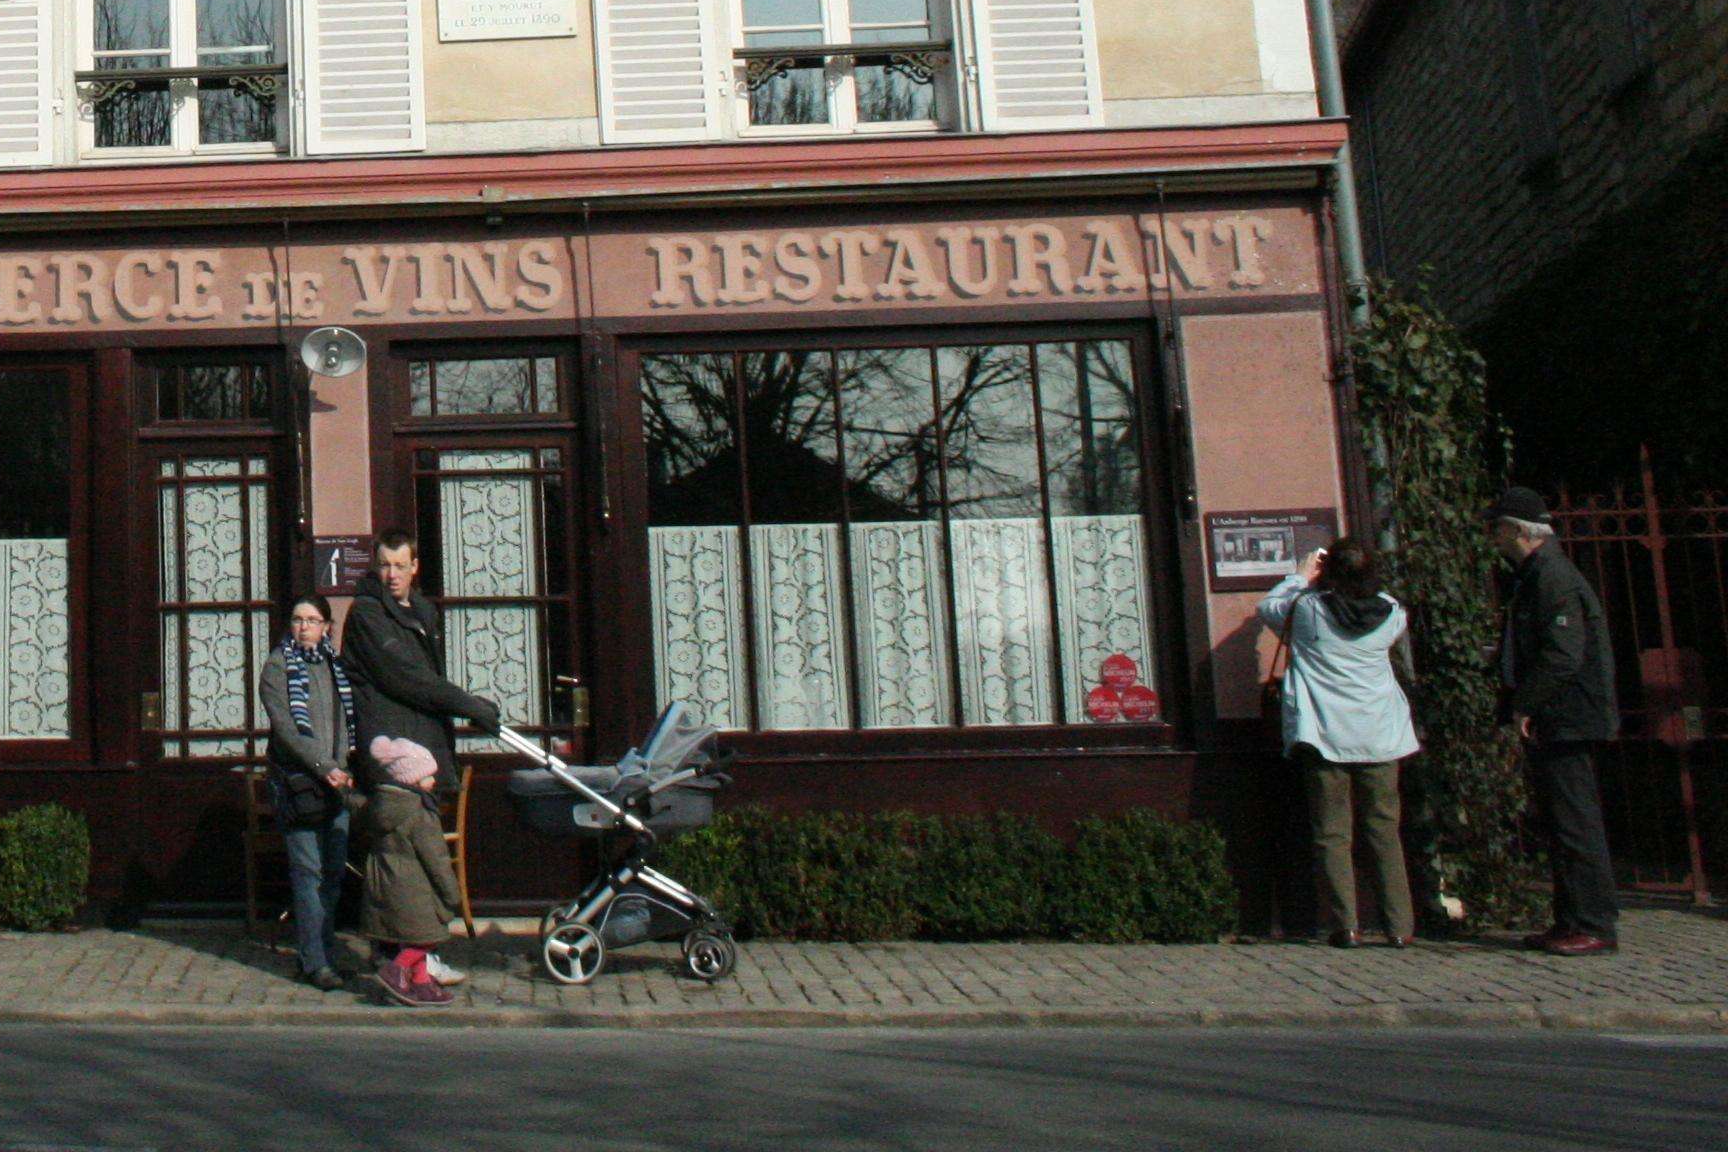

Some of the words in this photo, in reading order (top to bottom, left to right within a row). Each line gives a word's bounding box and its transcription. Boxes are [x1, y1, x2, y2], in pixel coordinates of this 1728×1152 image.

[531, 13, 561, 25] 1890
[242, 271, 325, 323] DE
[341, 240, 569, 317] VINS
[646, 215, 1275, 309] RESTAURANT
